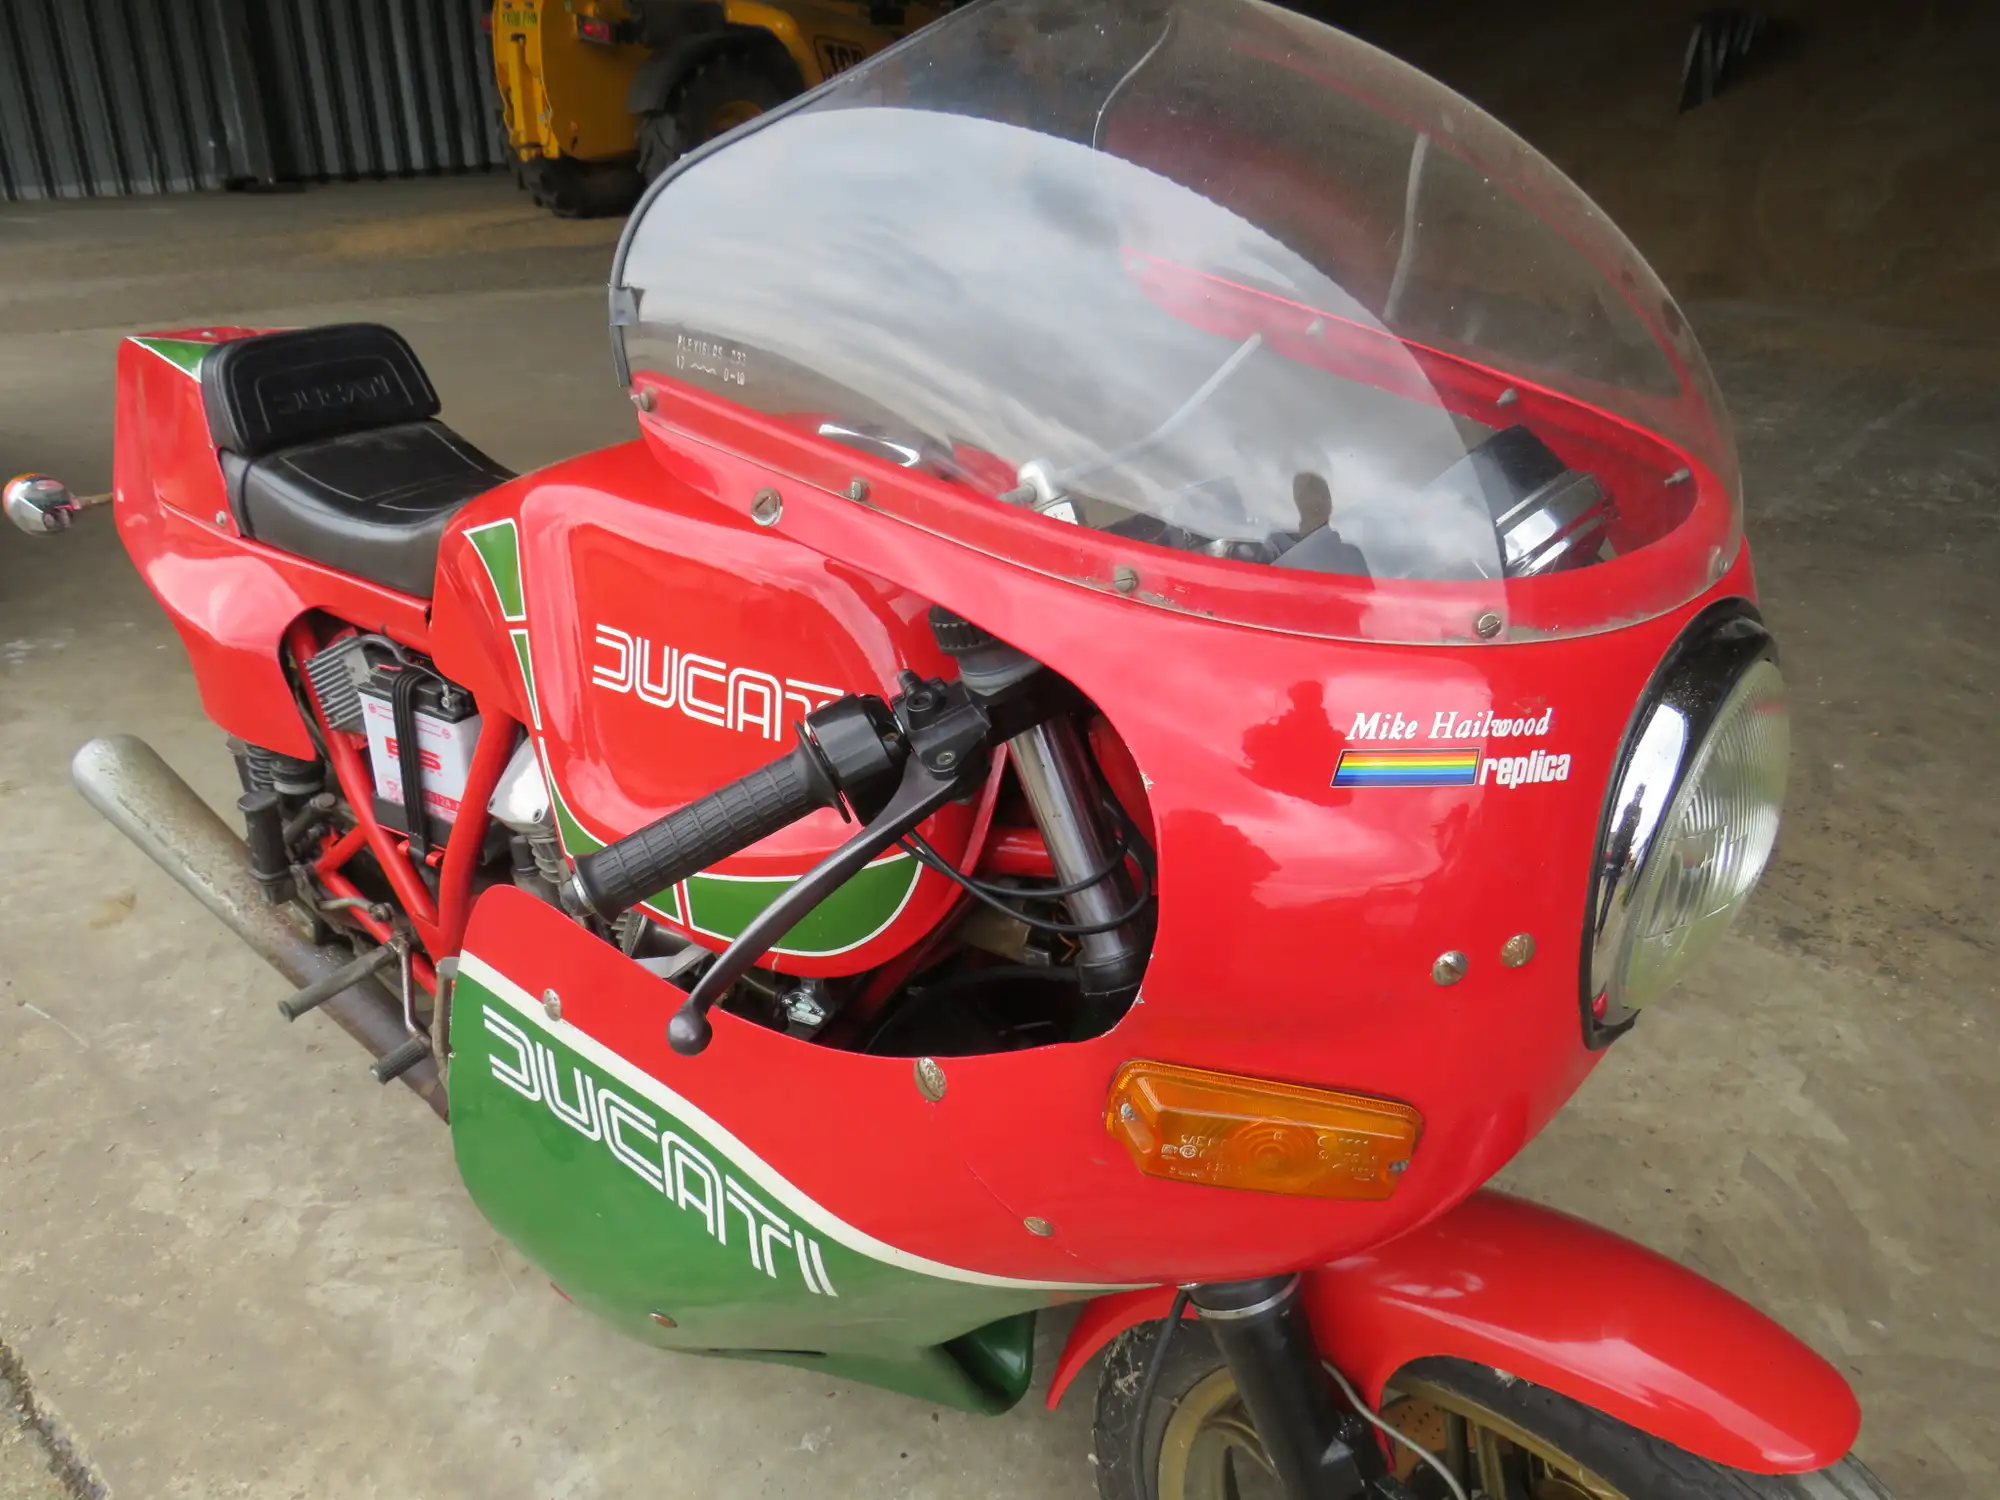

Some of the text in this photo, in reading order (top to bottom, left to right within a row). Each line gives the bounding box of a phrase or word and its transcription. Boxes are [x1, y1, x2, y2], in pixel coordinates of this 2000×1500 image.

[592, 623, 845, 742] DUCAT
[1345, 708, 1553, 741] Mike Hailwood
[1479, 749, 1572, 790] replica
[482, 1004, 839, 1298] DUCATI
